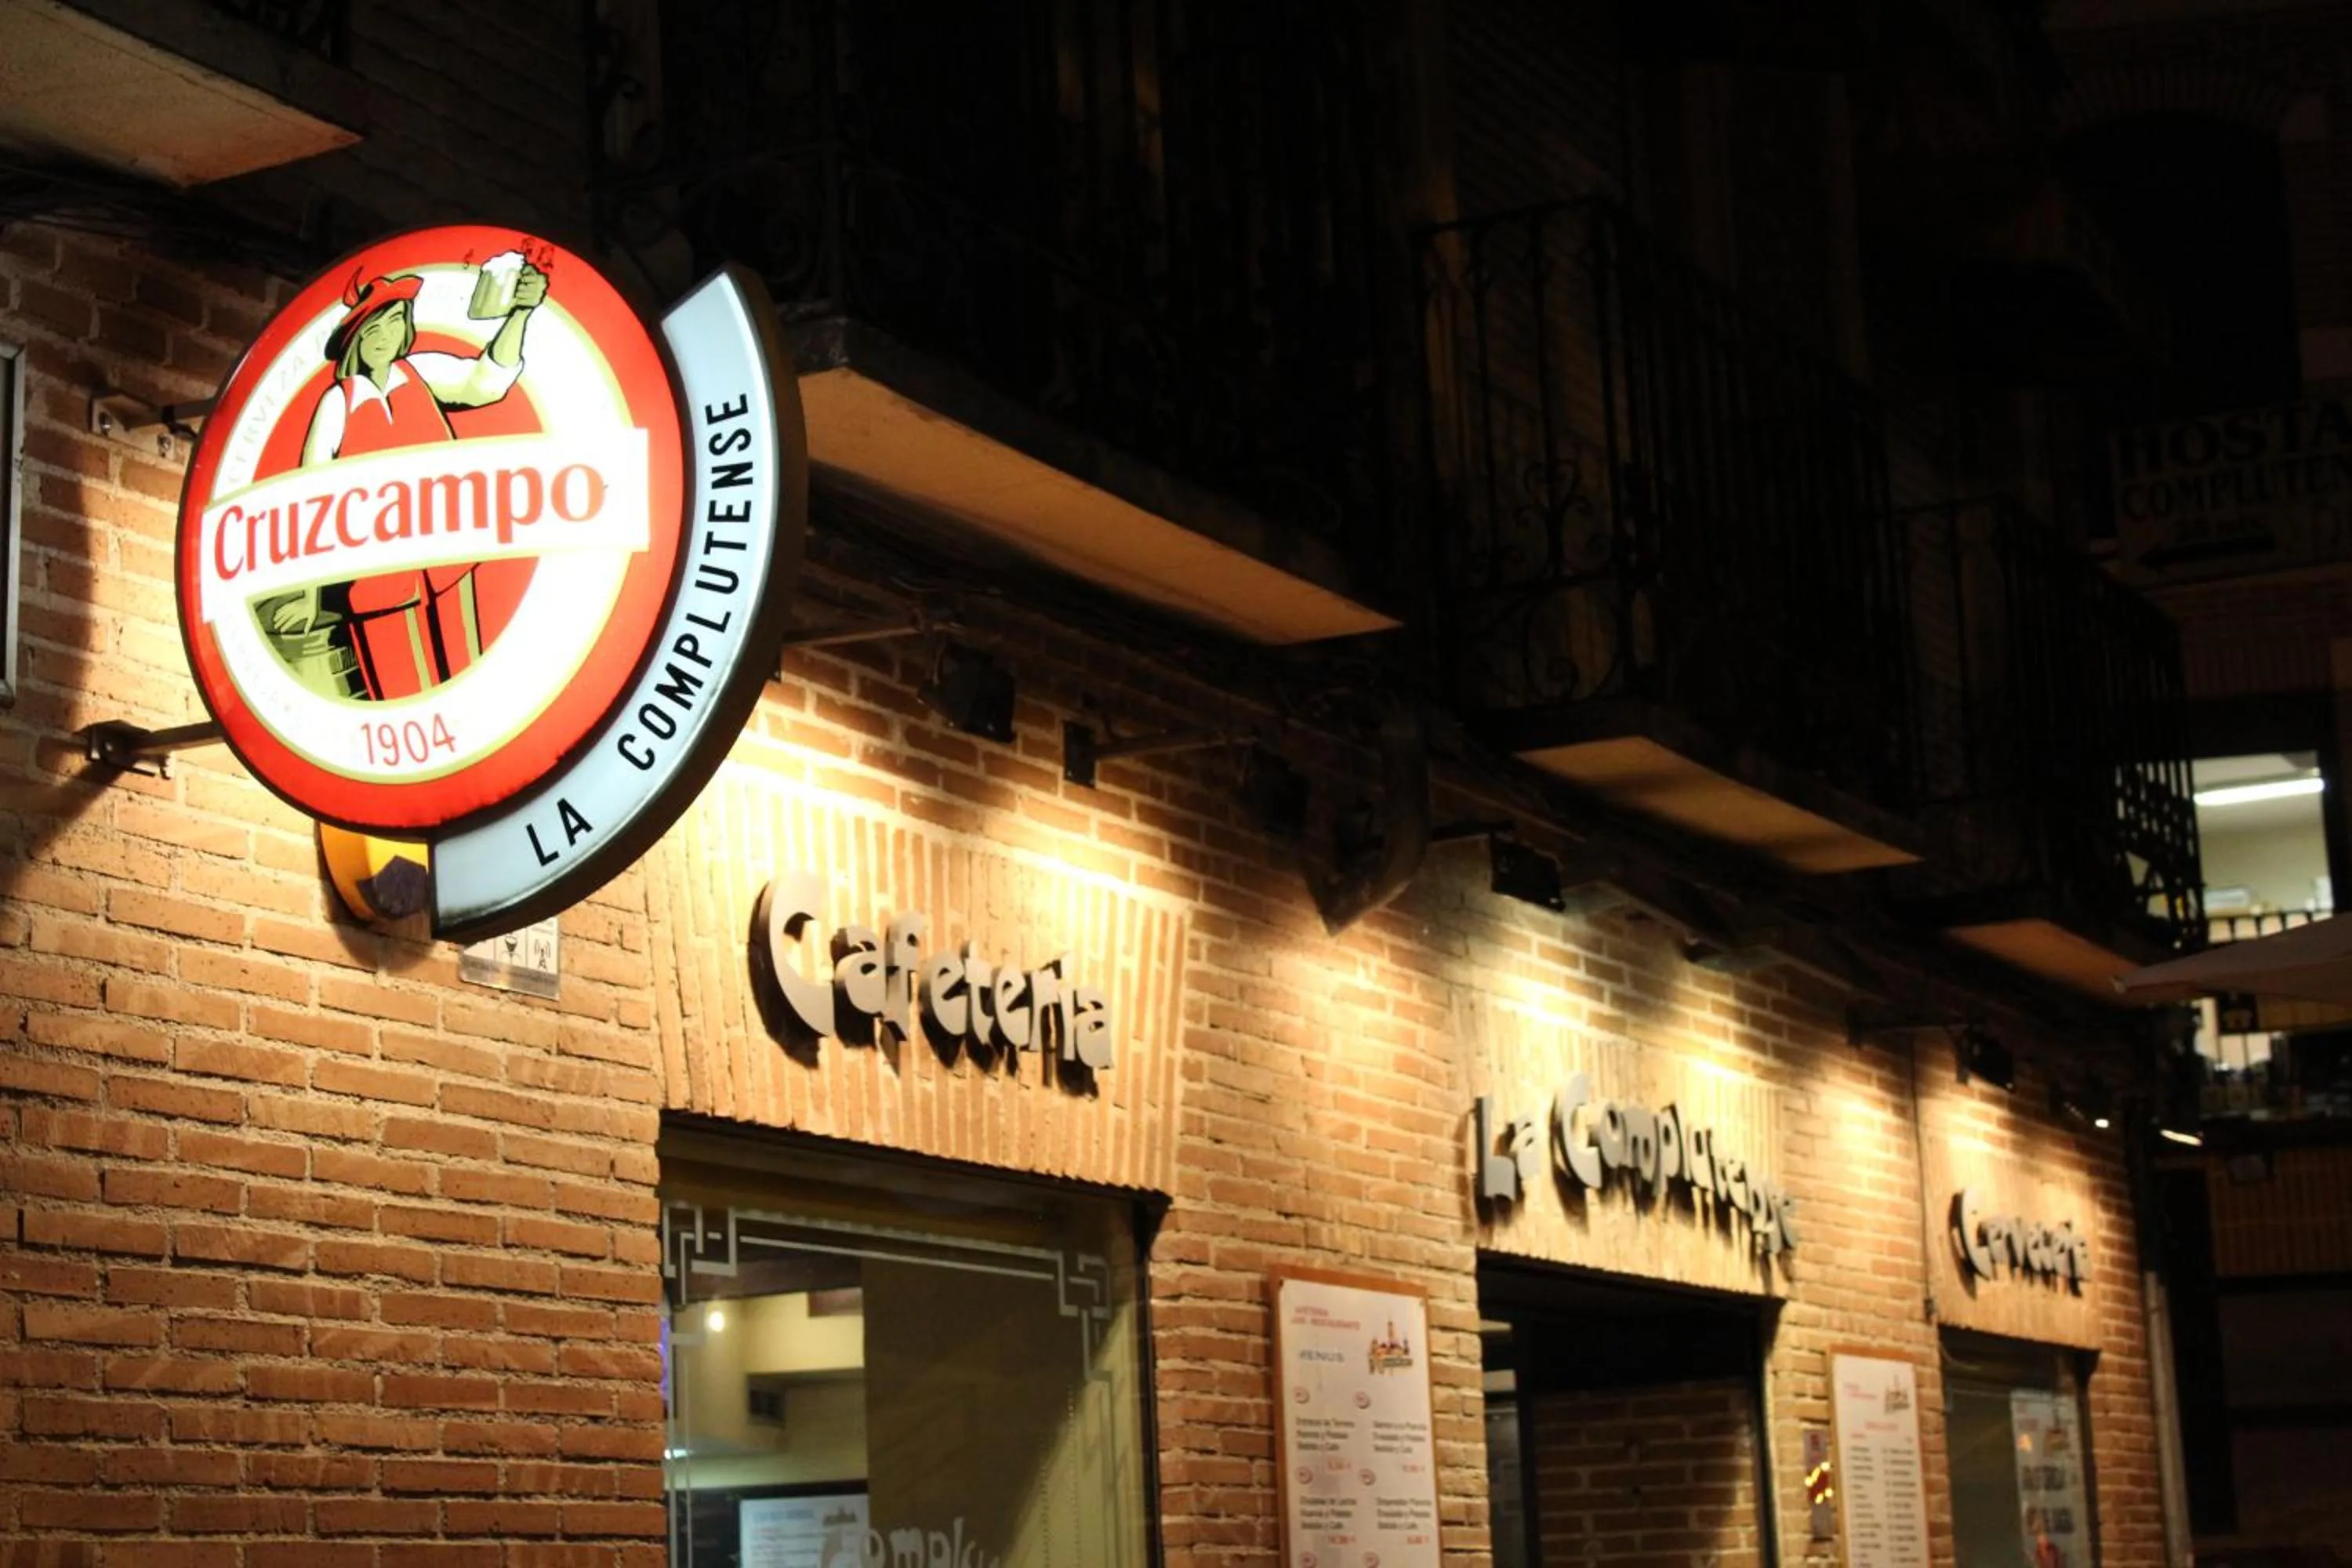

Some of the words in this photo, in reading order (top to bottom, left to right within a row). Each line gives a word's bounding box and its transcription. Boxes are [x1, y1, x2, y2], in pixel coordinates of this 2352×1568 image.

[214, 463, 605, 582] Cruzcampo
[525, 798, 593, 866] LA
[616, 393, 754, 771] COMPLUTENSE
[360, 713, 456, 767] 1904
[1476, 1096, 1541, 1203] La
